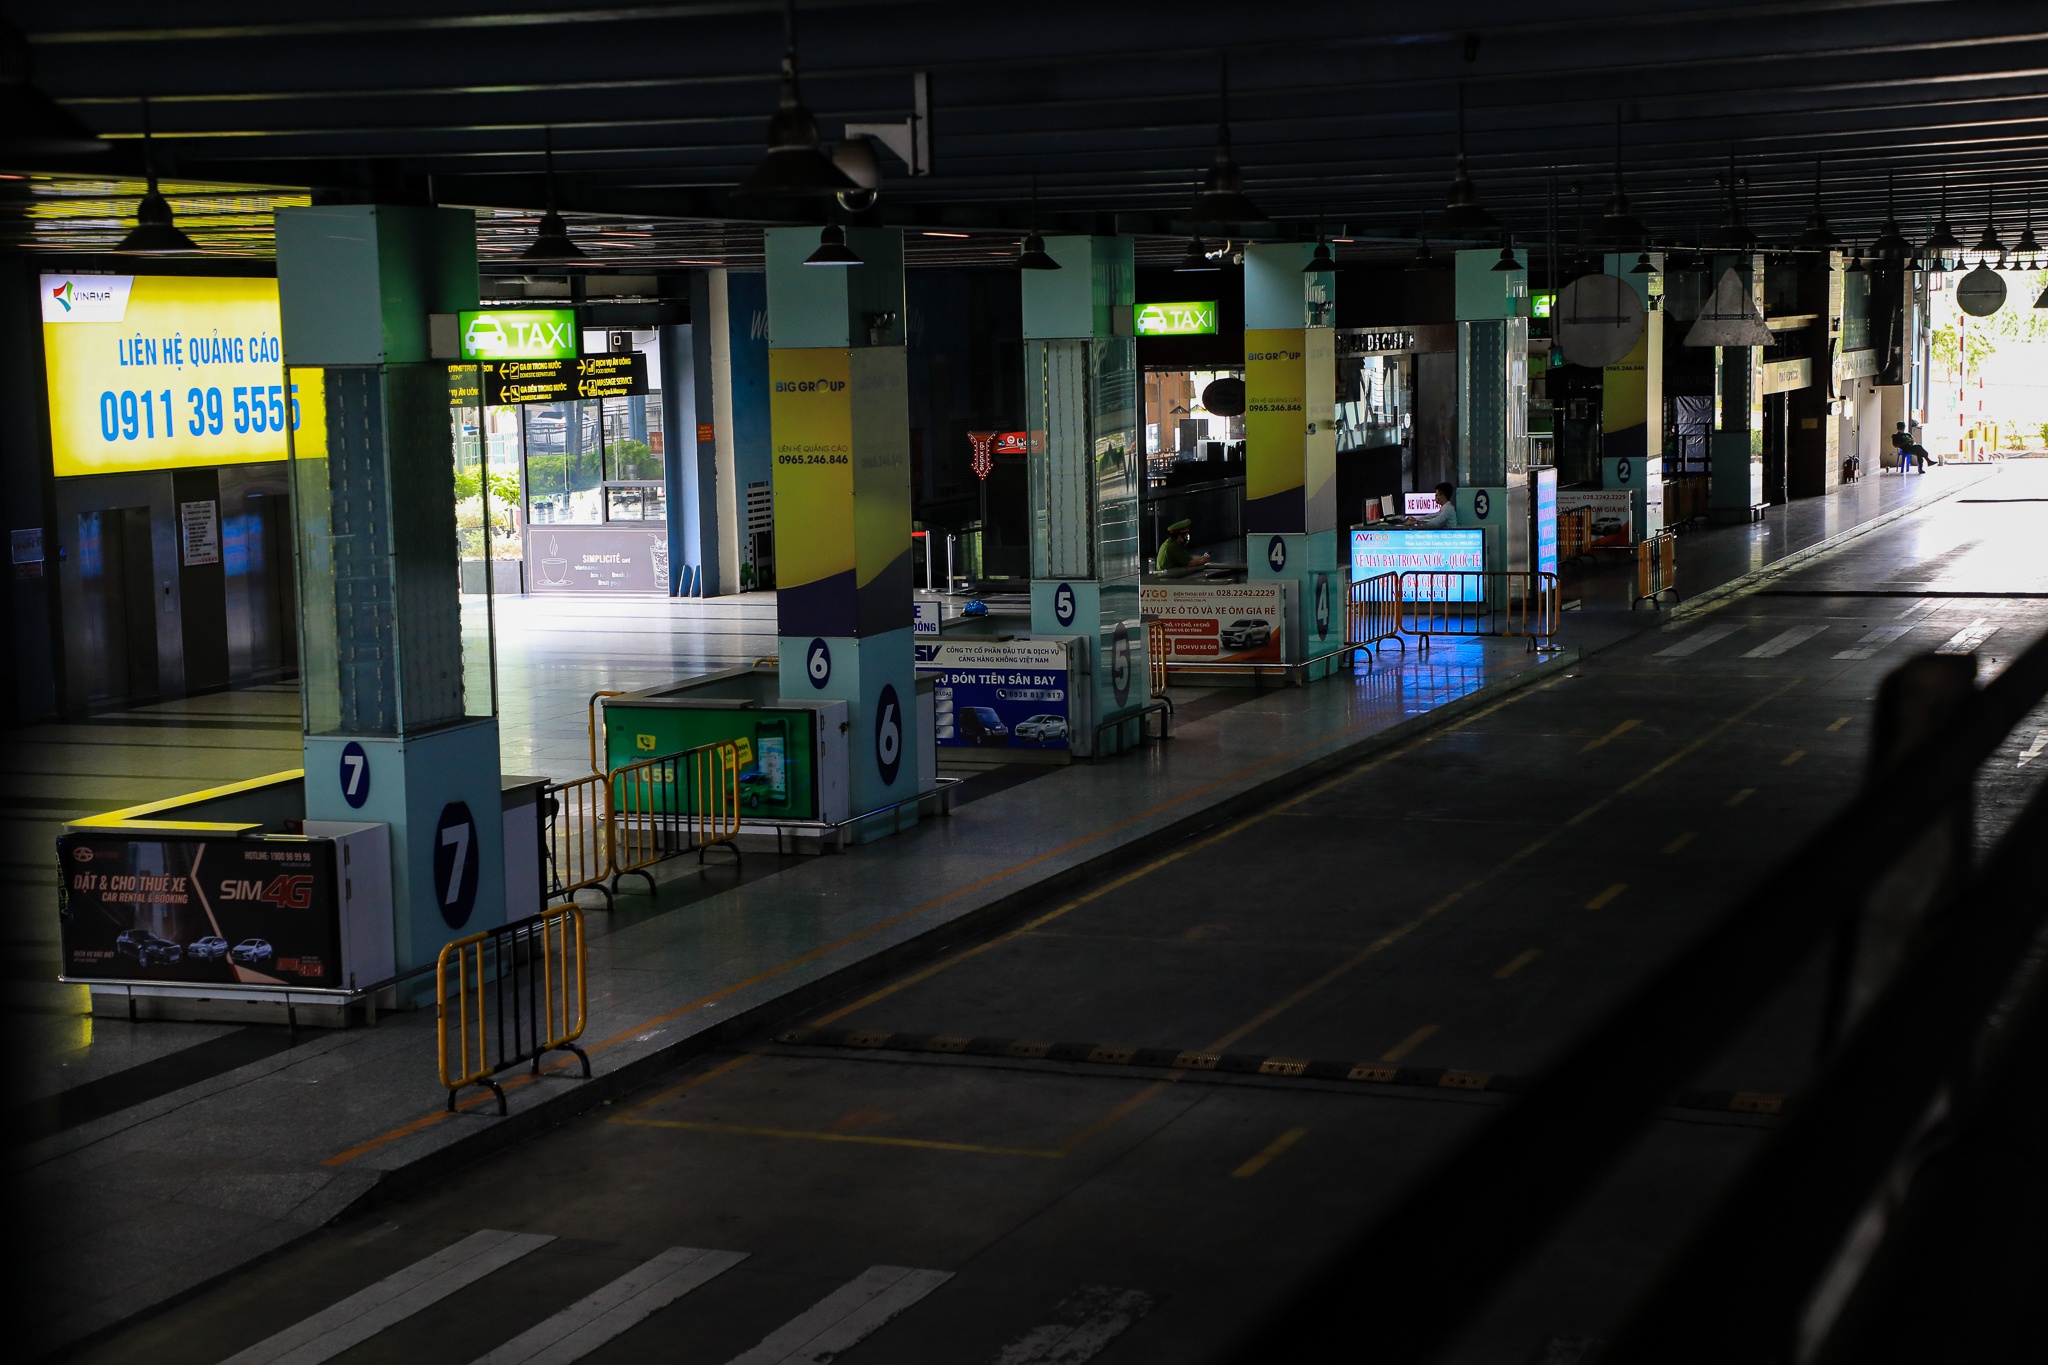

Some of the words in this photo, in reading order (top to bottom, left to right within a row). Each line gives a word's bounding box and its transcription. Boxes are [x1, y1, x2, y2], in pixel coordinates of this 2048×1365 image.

[74, 292, 110, 301] VINAMA
[1169, 310, 1212, 329] TAXI
[511, 322, 573, 349] TAXI
[119, 332, 157, 366] LIÊN
[163, 332, 183, 371] HỆ
[189, 328, 244, 367] QUẢNG
[249, 331, 279, 363] CÁO
[1248, 352, 1264, 361] BIG
[1265, 350, 1301, 361] GROUP
[775, 381, 796, 392] BIG
[798, 378, 846, 394] GROUP
[100, 389, 173, 441] 0911
[187, 387, 223, 436] 39
[778, 455, 848, 464] 0965.246.846
[1619, 462, 1629, 479] 2
[1407, 499, 1415, 509] XE
[1476, 495, 1488, 514] 3
[582, 552, 621, 563] SIMPLICITÉ
[1269, 542, 1284, 565] 4
[1216, 589, 1275, 597] 028.2242.2229
[1057, 591, 1073, 619] 5
[1150, 606, 1163, 616] VỤ
[1165, 606, 1176, 614] XE
[1178, 605, 1185, 615] Ô
[1187, 605, 1199, 615] TÔ
[1200, 605, 1213, 614] VÀ
[1215, 606, 1226, 615] XE
[1229, 605, 1244, 615] ÔM
[1246, 605, 1262, 615] GIÁ
[1265, 604, 1276, 615] RẺ
[1317, 582, 1329, 628] 4
[946, 646, 964, 654] CÔNG
[965, 646, 973, 654] TY
[984, 645, 1001, 654] PHẦN
[1002, 645, 1016, 655] ĐẦU
[1016, 647, 1026, 655] TƯ
[1033, 648, 1049, 657] DỊCH
[1050, 649, 1060, 657] VỤ
[977, 654, 994, 663] HÀNG
[995, 654, 1018, 663] KHÔNG
[1019, 655, 1033, 664] VIỆT
[811, 647, 828, 679] 6
[1115, 648, 1131, 692] 5
[951, 672, 976, 684] ĐÓN
[979, 671, 1005, 685] TIỄN
[1008, 672, 1031, 685] SÂN
[1034, 675, 1056, 686] BAY
[879, 703, 900, 766] 6
[344, 755, 364, 795] 7
[442, 822, 469, 906] 7
[73, 871, 98, 893] ĐẶT
[99, 875, 107, 890] &
[110, 875, 136, 891] CHO
[140, 872, 169, 892] THUÊ
[171, 877, 187, 892] XE
[101, 892, 118, 903] CAR
[119, 892, 145, 903] RENTAL
[147, 894, 153, 903] &
[155, 893, 188, 904] BOOKING
